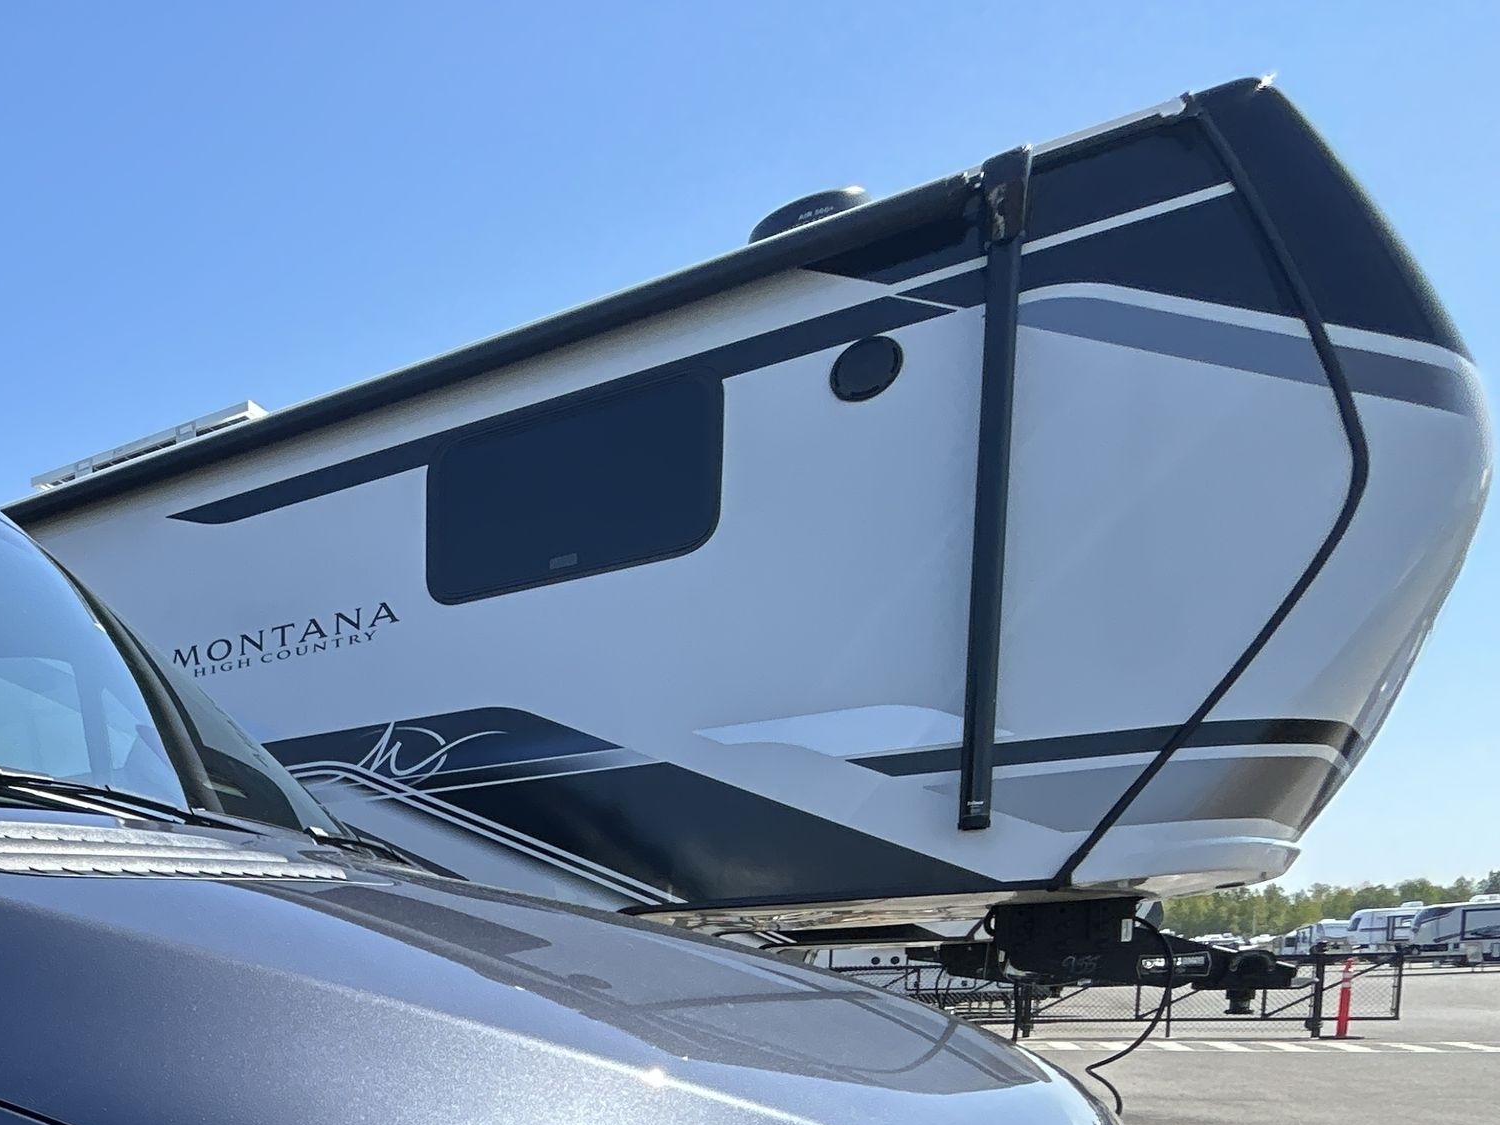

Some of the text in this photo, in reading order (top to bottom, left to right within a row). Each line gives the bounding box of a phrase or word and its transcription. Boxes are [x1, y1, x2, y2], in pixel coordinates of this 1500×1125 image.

[172, 601, 400, 669] MONTANA
[193, 629, 377, 678] HIGH COUNTRY
